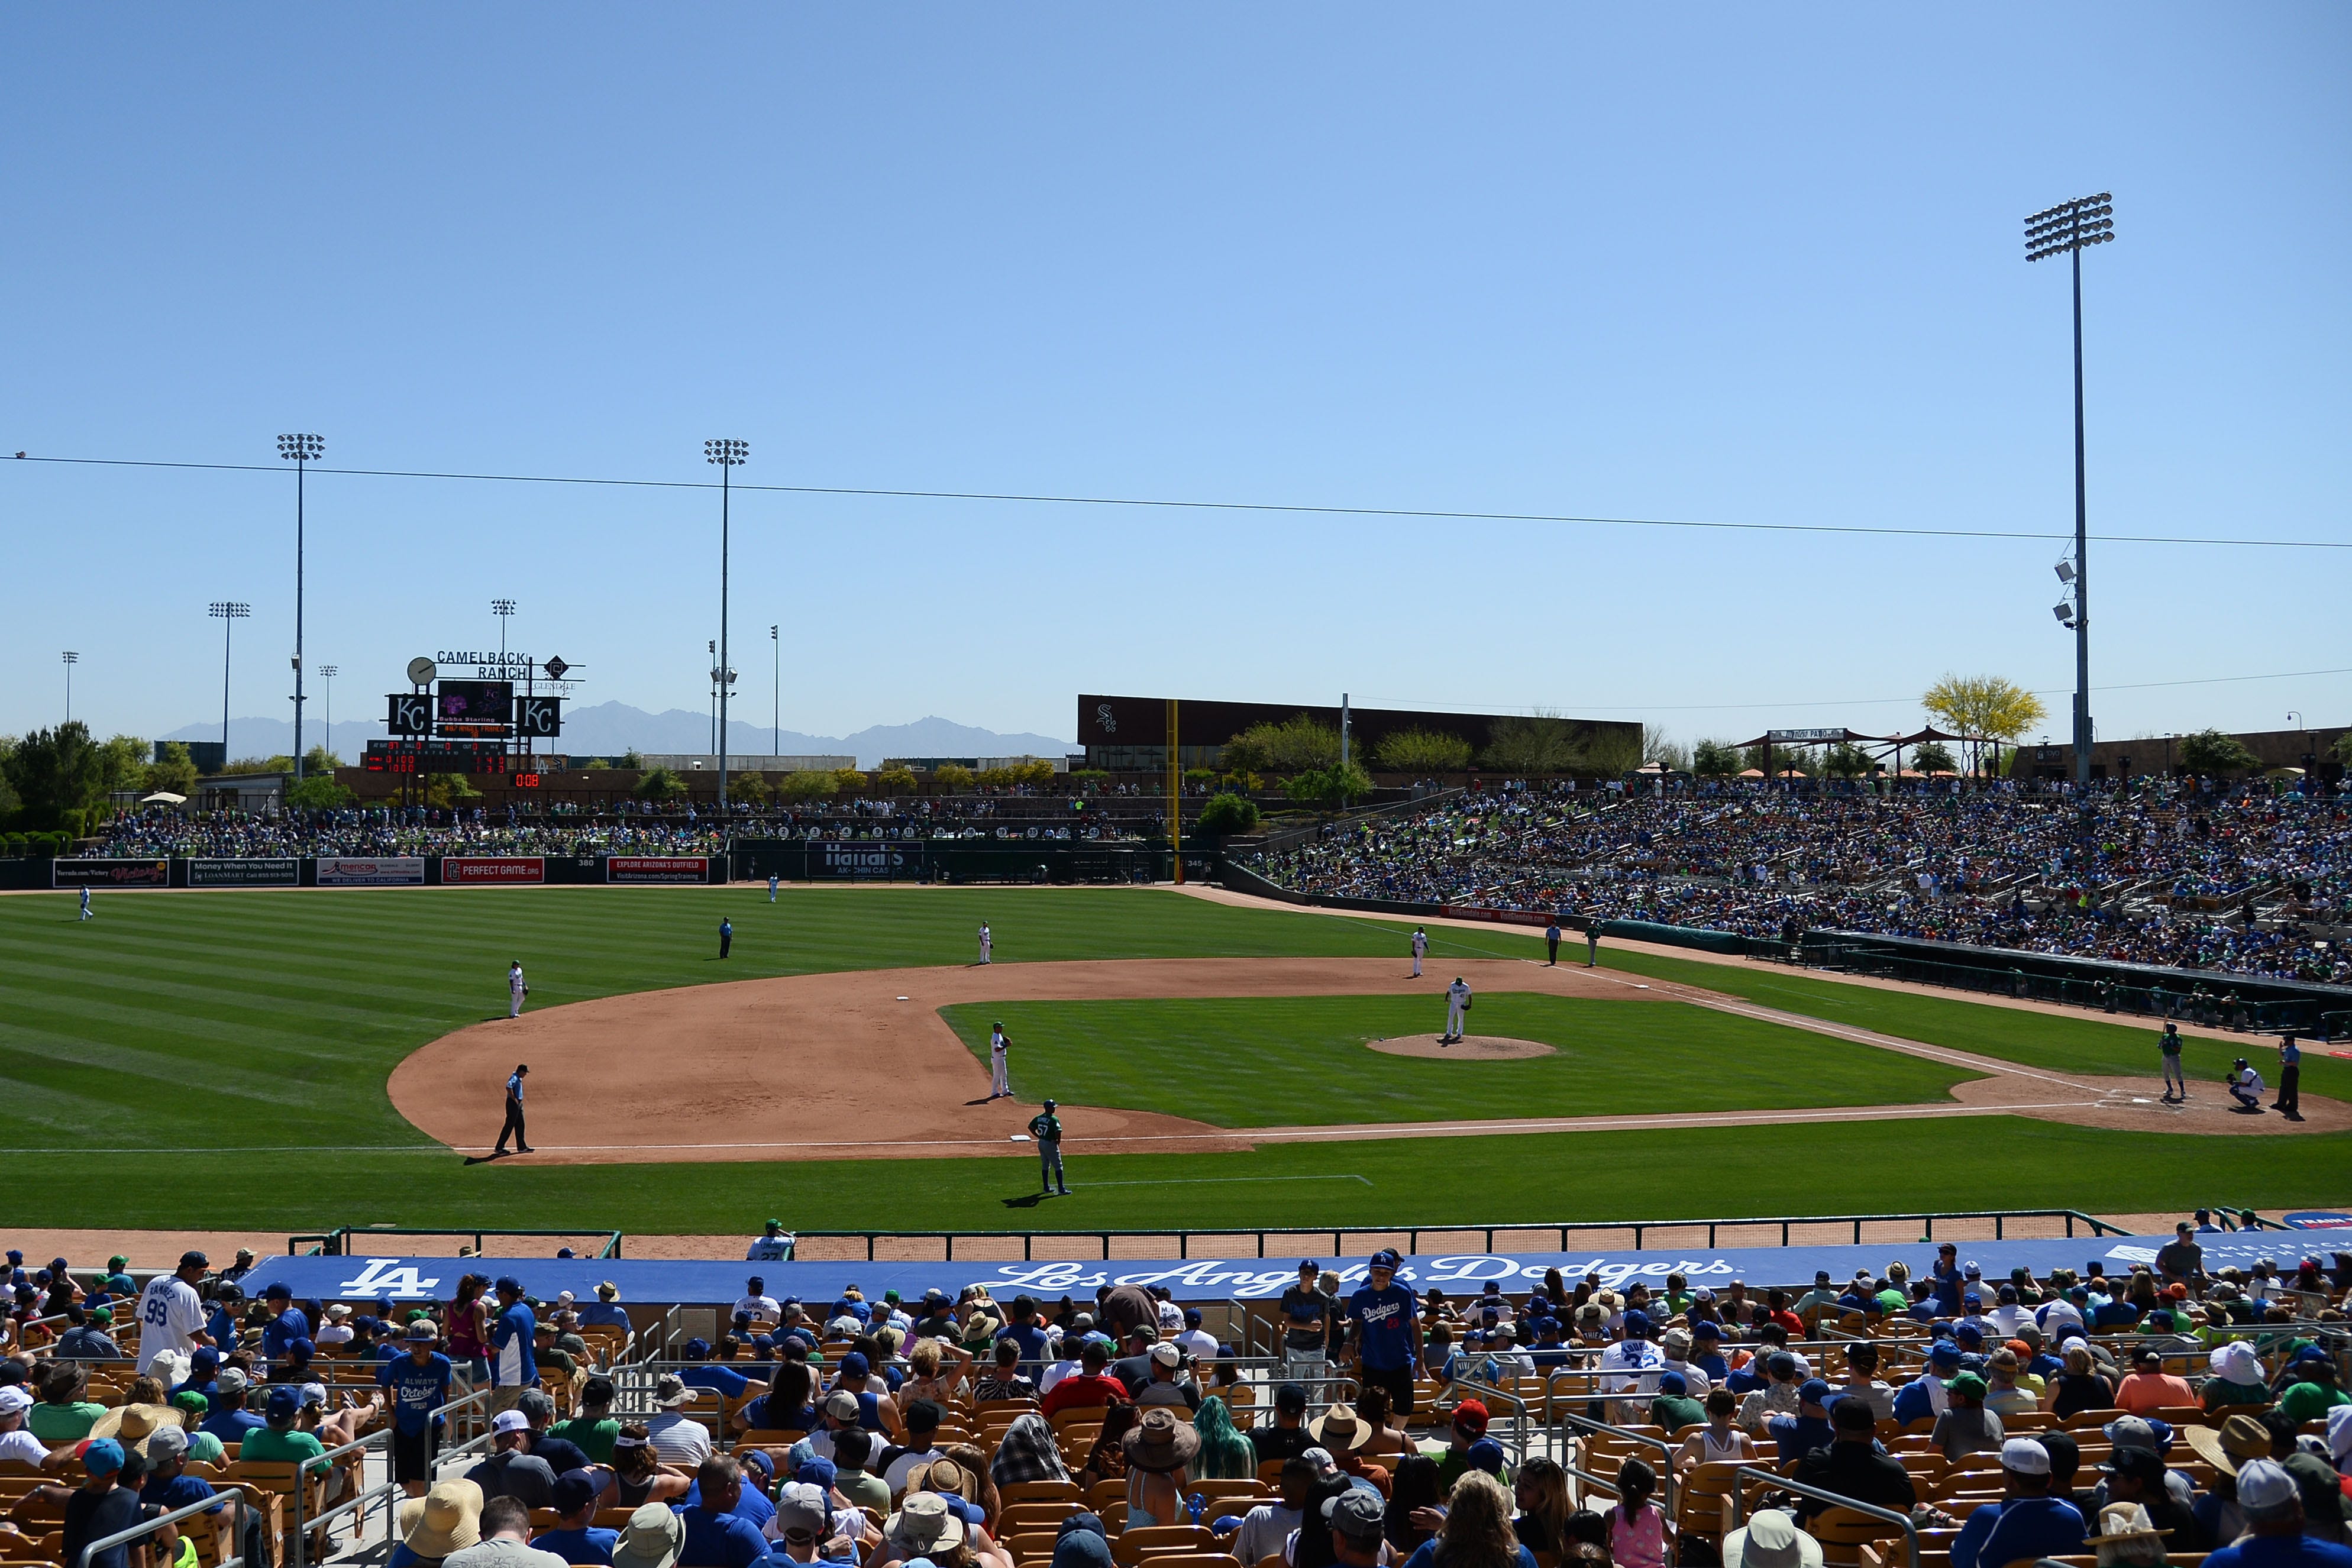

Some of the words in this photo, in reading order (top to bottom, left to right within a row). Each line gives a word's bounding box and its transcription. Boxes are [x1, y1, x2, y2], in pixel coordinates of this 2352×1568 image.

[437, 651, 525, 664] CAMELBACK
[479, 667, 526, 680] RANCH
[396, 698, 424, 730] KC
[524, 700, 552, 732] KC
[535, 755, 549, 774] LA
[110, 866, 165, 881] Victory
[463, 865, 499, 875] PERFECT
[1449, 907, 1491, 919] VisitGlendale.com
[1500, 911, 1546, 923] VisitGlendale.com
[1038, 1124, 1048, 1136] 57
[2202, 1242, 2352, 1252] AMELBACK
[339, 1259, 440, 1297] LA
[970, 1262, 1108, 1291] Los
[1114, 1260, 1417, 1297] Angls
[1425, 1256, 1734, 1288] Dodgers
[150, 1285, 176, 1302] RAMIREZ
[144, 1299, 168, 1327] 99
[743, 1302, 768, 1311] RAMIREZ
[1362, 1302, 1400, 1320] Dodgers
[1387, 1318, 1400, 1329] 23
[1584, 1331, 1604, 1340] THIER
[400, 1385, 436, 1398] October
